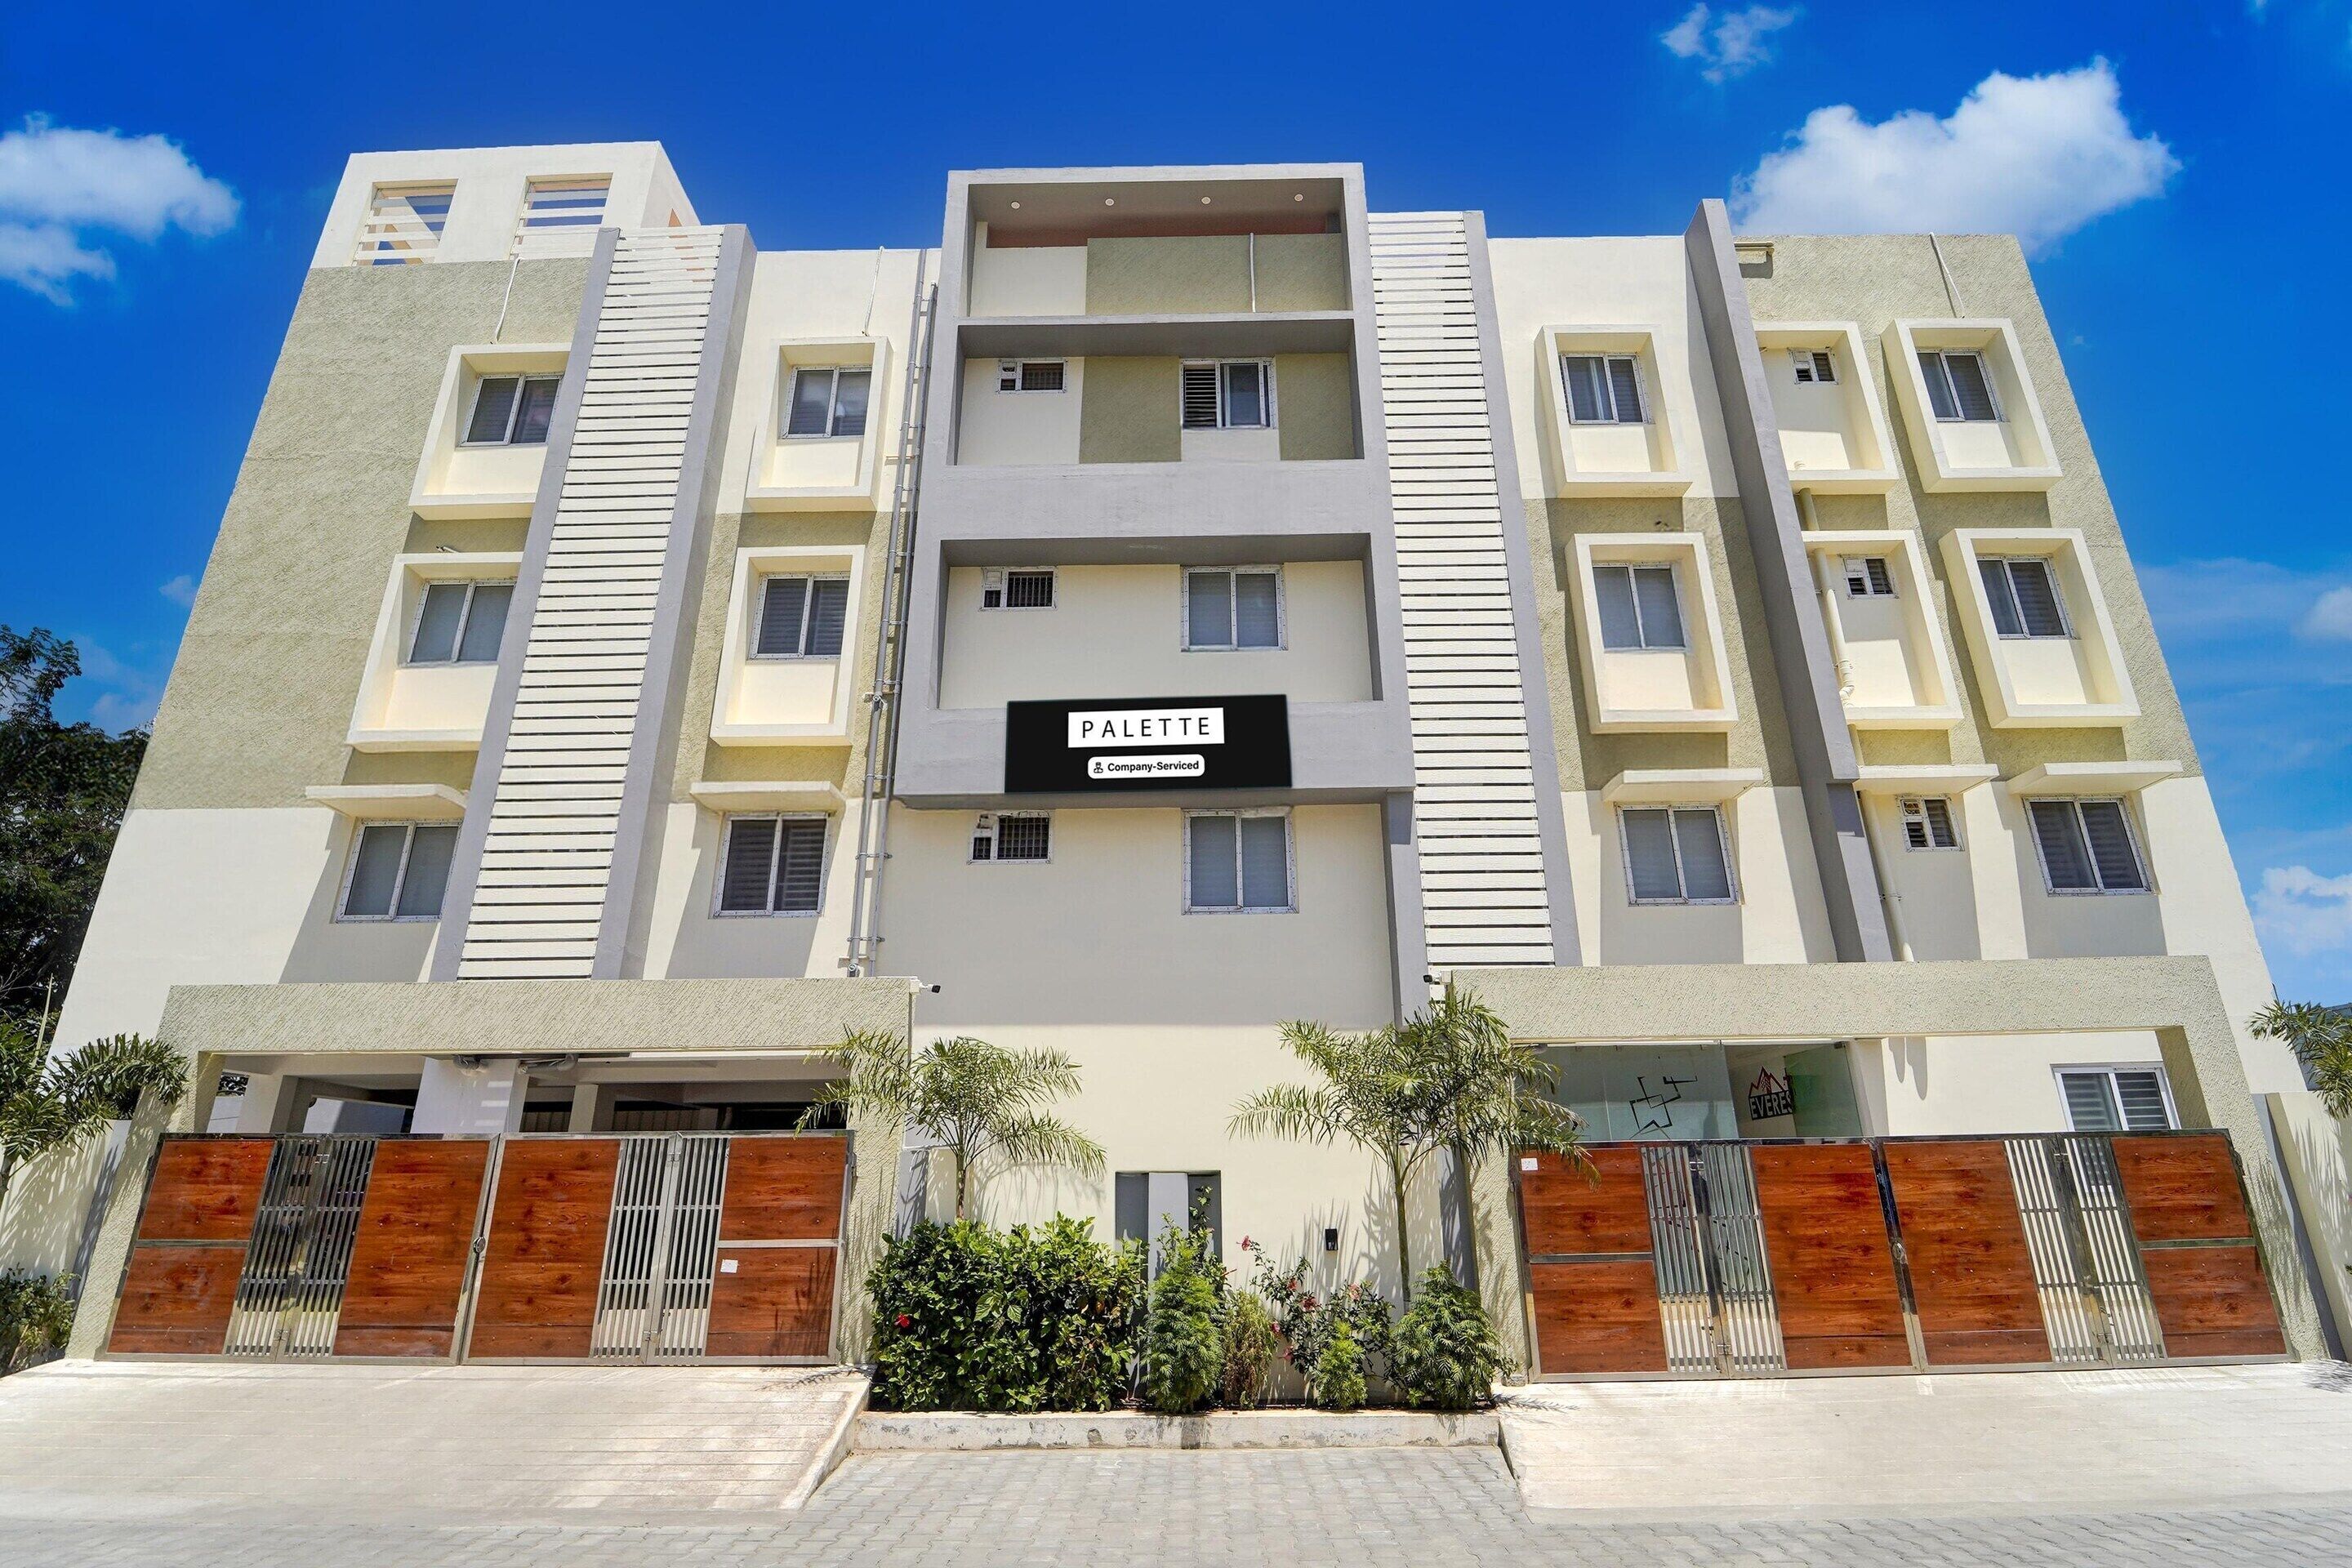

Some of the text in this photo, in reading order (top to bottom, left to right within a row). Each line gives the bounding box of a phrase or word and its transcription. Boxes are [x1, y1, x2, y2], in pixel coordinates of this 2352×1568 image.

[1082, 717, 1209, 738] PALETTE
[1107, 760, 1199, 773] Company-Serviced
[1749, 1090, 1793, 1119] EVERES
